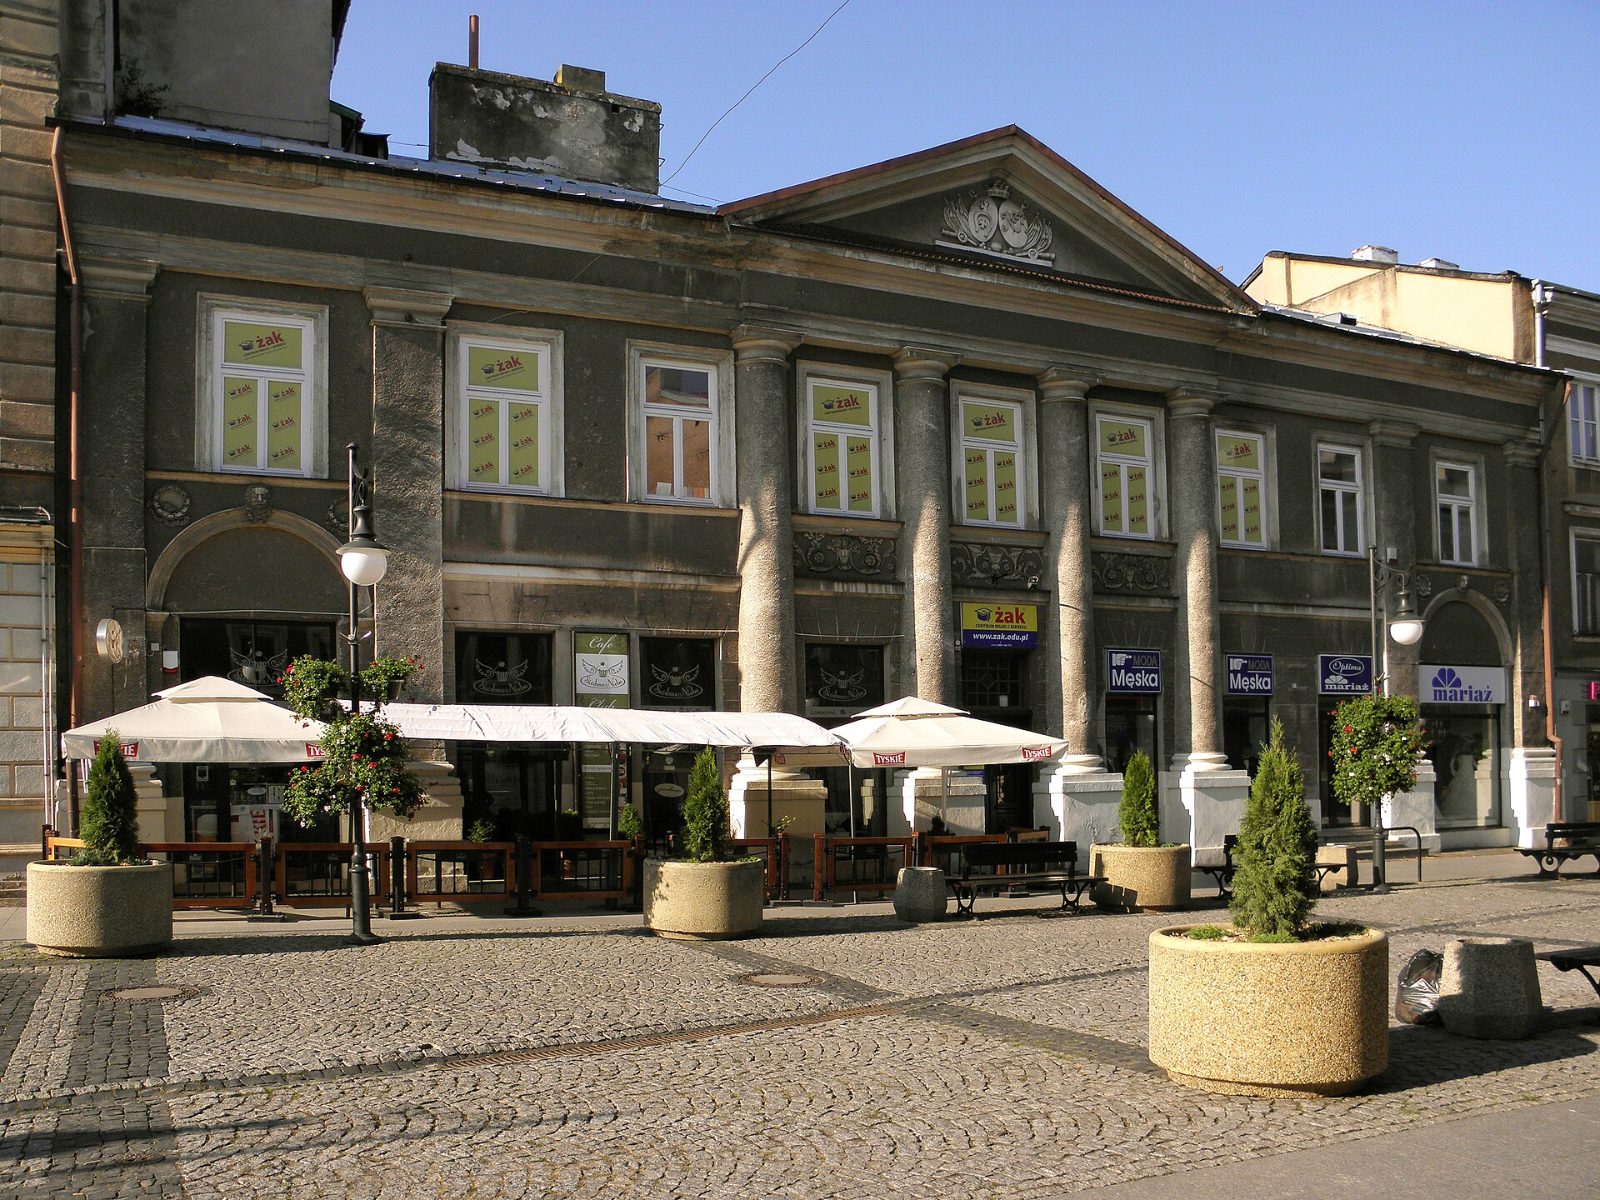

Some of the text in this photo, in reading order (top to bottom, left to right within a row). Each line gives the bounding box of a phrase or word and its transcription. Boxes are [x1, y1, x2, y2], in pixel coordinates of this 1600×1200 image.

[256, 331, 285, 349] żak
[496, 355, 522, 372] żak
[836, 394, 859, 409] żak
[984, 412, 1006, 426] żak
[1118, 429, 1137, 441] żak
[995, 607, 1026, 624] żak
[1133, 655, 1158, 666] MODA
[1248, 659, 1271, 670] MODA
[1332, 660, 1362, 673] Optima
[1112, 669, 1158, 688] Męska
[1230, 673, 1271, 692] Męska
[1324, 682, 1369, 690] mariaż
[1433, 685, 1492, 702] mariaż
[875, 754, 904, 763] TYSKIE
[1024, 748, 1051, 758] TYSKIE
